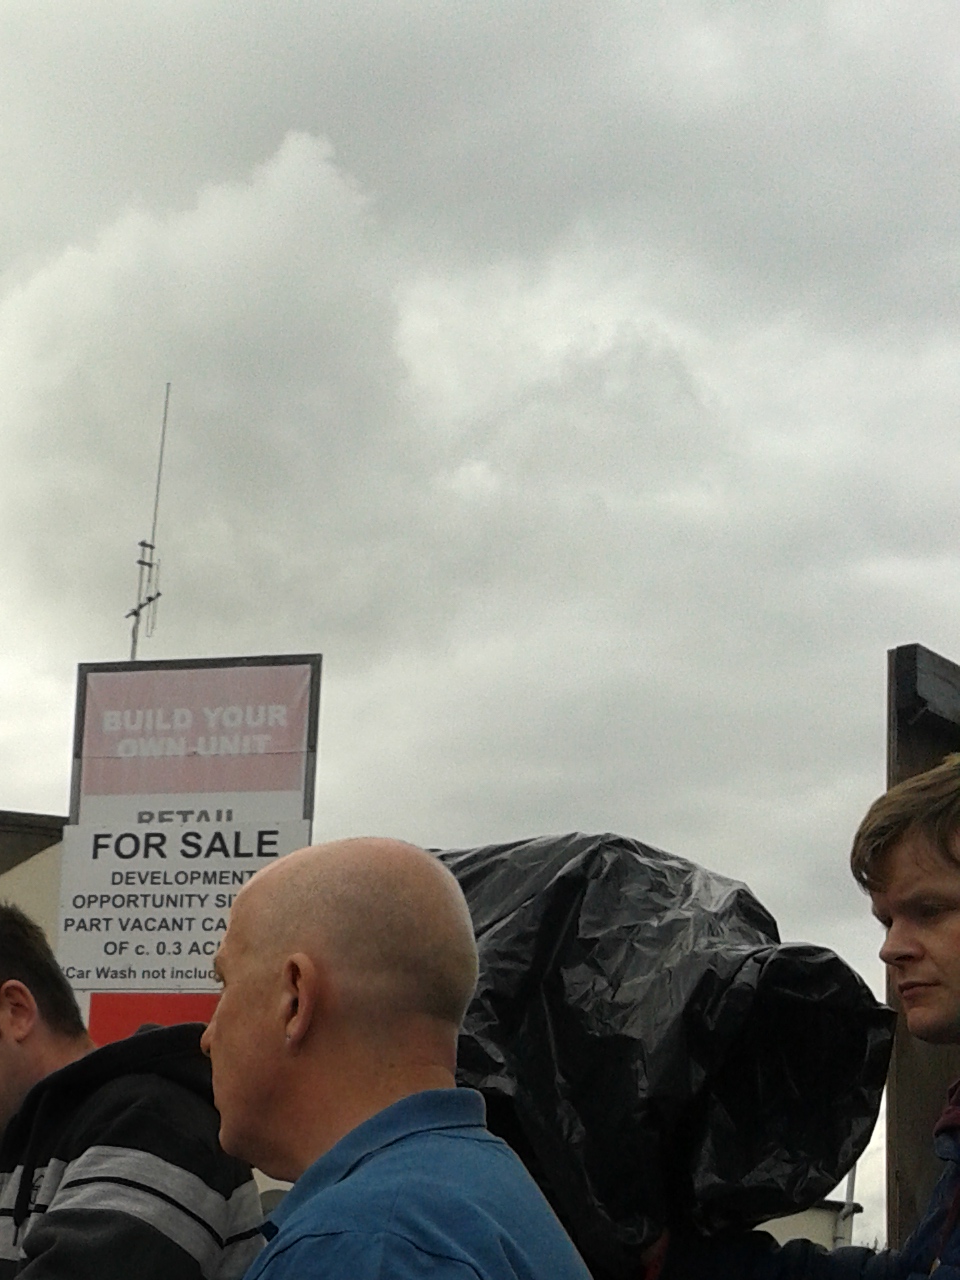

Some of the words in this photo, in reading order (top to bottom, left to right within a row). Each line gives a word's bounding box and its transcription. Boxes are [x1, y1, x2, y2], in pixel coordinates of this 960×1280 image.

[103, 708, 192, 733] BUILD
[203, 705, 287, 728] YOUR
[117, 737, 187, 758] OWN
[196, 734, 271, 755] UNIT
[92, 832, 167, 860] FOR
[179, 830, 280, 859] SALE
[111, 870, 257, 886] DEVELOPMENT
[72, 893, 209, 909] OPPORTUNITY
[214, 893, 237, 908] SI
[63, 917, 113, 932] PART
[118, 917, 196, 931] VACANT
[103, 941, 130, 955] OF
[135, 944, 150, 955] c.
[156, 941, 182, 955] 0.3
[96, 967, 137, 979] Wash
[142, 968, 166, 979] not
